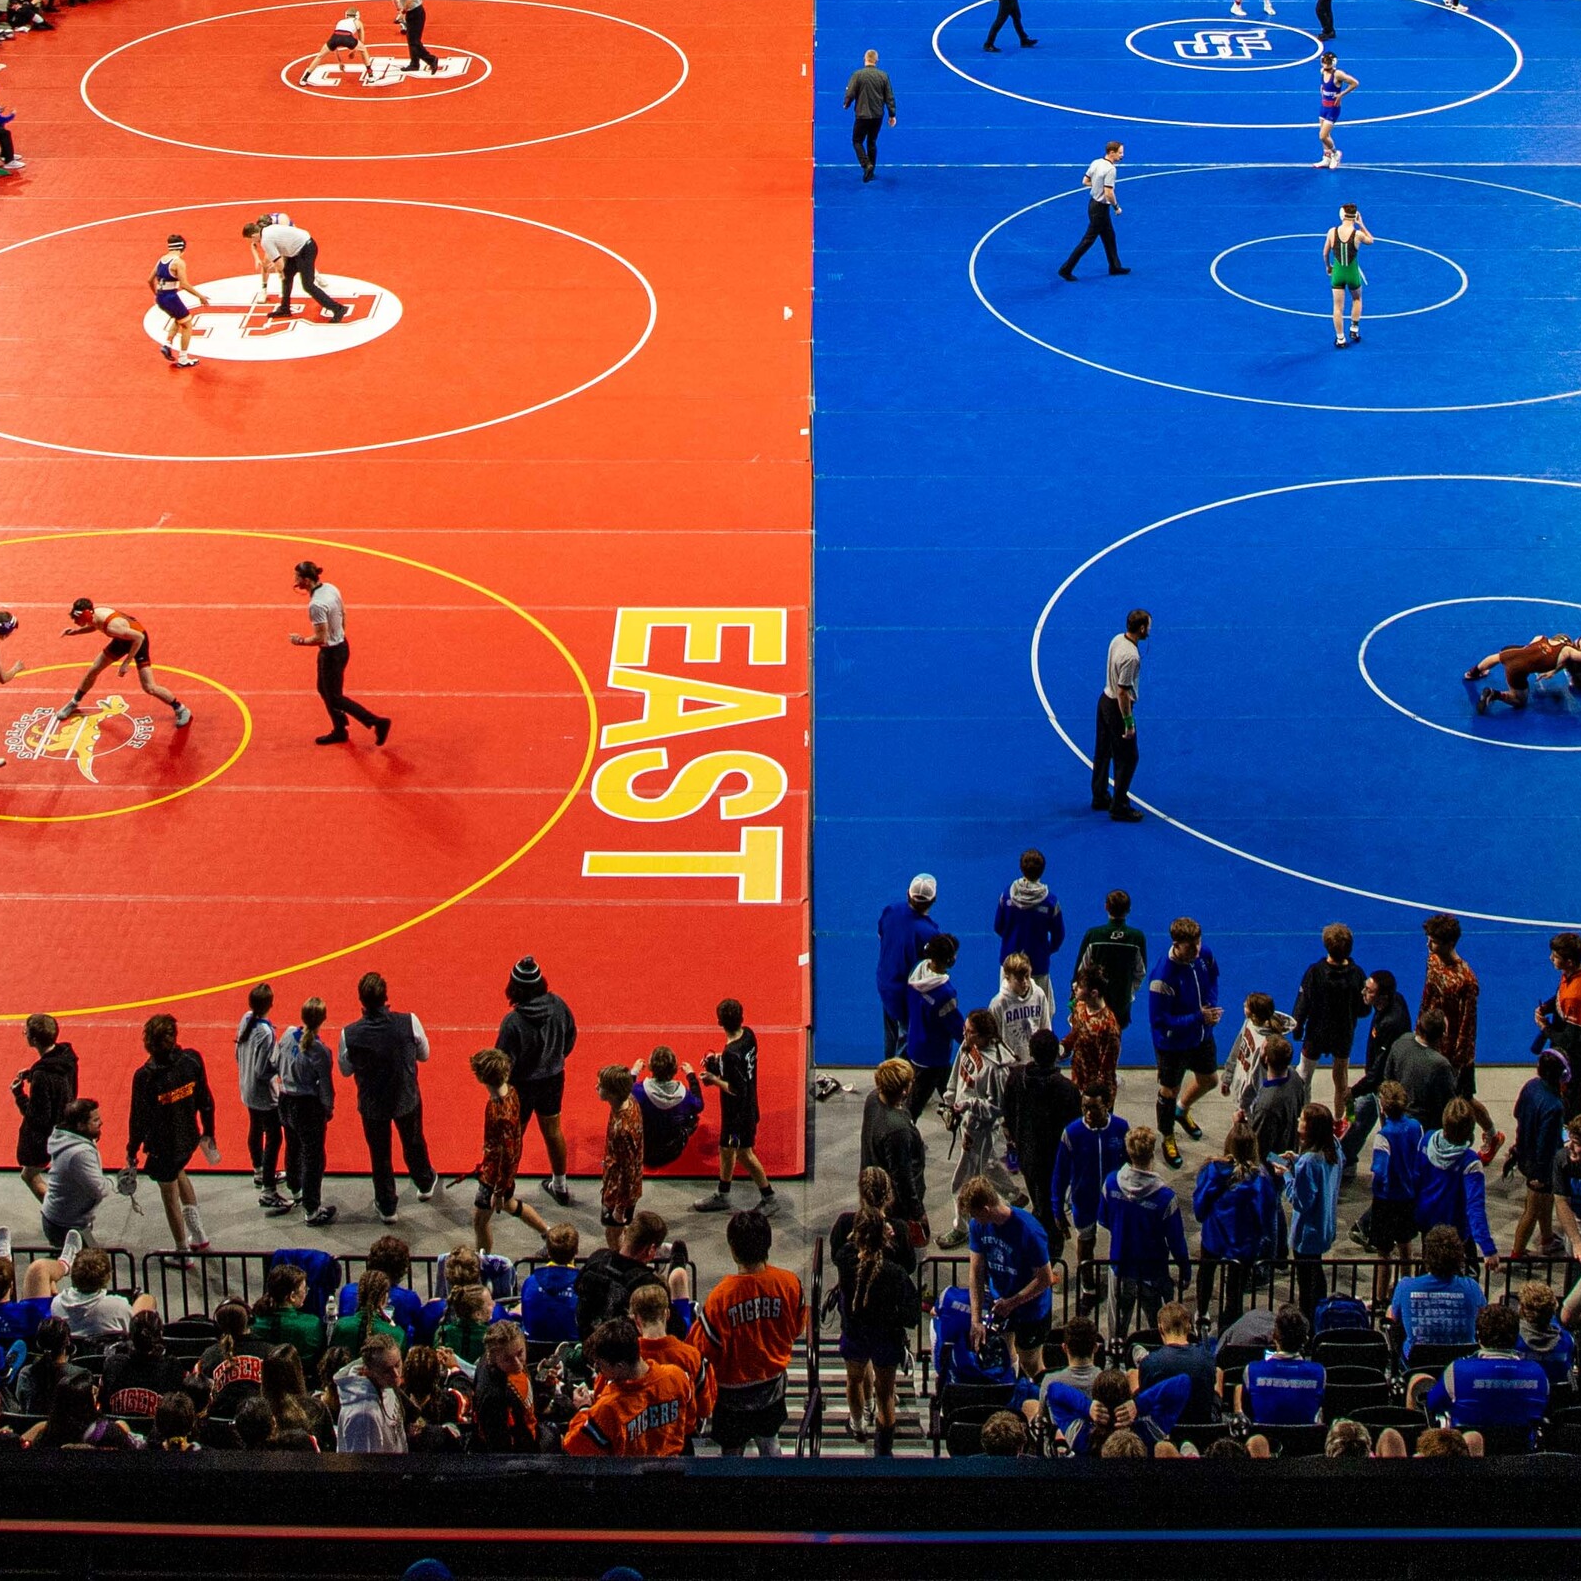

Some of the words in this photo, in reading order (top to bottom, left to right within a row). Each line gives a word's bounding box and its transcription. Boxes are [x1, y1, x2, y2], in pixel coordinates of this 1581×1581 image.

[582, 607, 787, 903] EAST
[728, 1297, 781, 1327] TIGERS
[213, 1355, 263, 1392] TIGER
[627, 1400, 679, 1442] TIGERS
